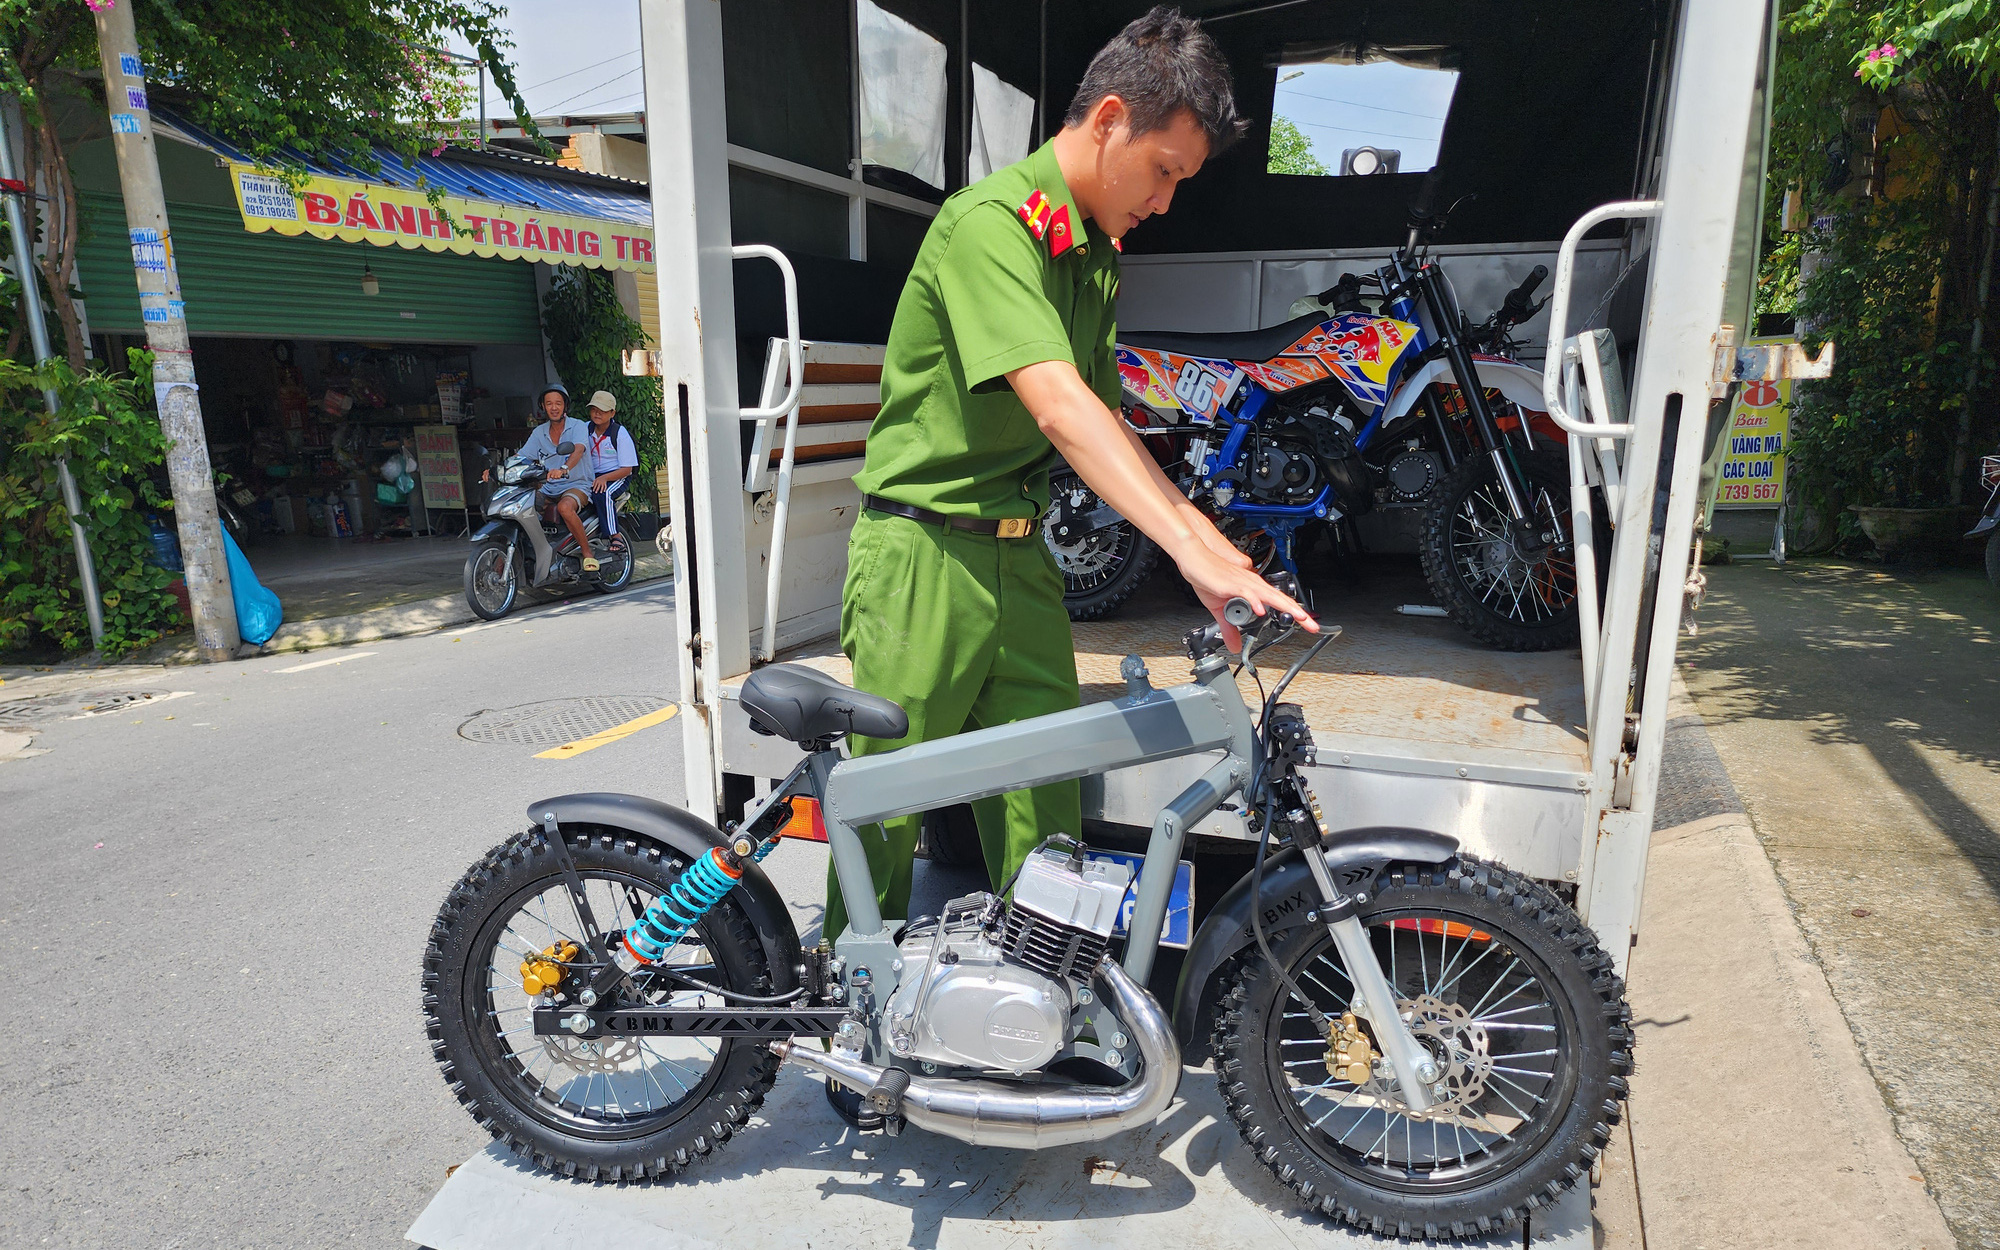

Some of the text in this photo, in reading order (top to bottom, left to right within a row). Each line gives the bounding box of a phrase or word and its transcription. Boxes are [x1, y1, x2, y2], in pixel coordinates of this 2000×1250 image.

[241, 180, 272, 194] THANH
[245, 204, 297, 219] 0913.190245
[303, 191, 655, 263] BÁNH TRÁNG TR
[1375, 323, 1395, 349] RACING
[1379, 320, 1404, 347] KTM
[1174, 360, 1219, 413] 86
[1735, 413, 1768, 427] Bán:
[419, 430, 455, 453] BÁNH
[1732, 432, 1782, 454] VÀNG MÃ
[421, 454, 459, 476] TRÁNG
[1723, 459, 1773, 481] CÁC LOẠI
[424, 478, 461, 506] TRỘN
[1724, 484, 1750, 500] 739
[1753, 483, 1779, 499] 567
[1264, 890, 1307, 925] BMX
[626, 1016, 674, 1032] BMX
